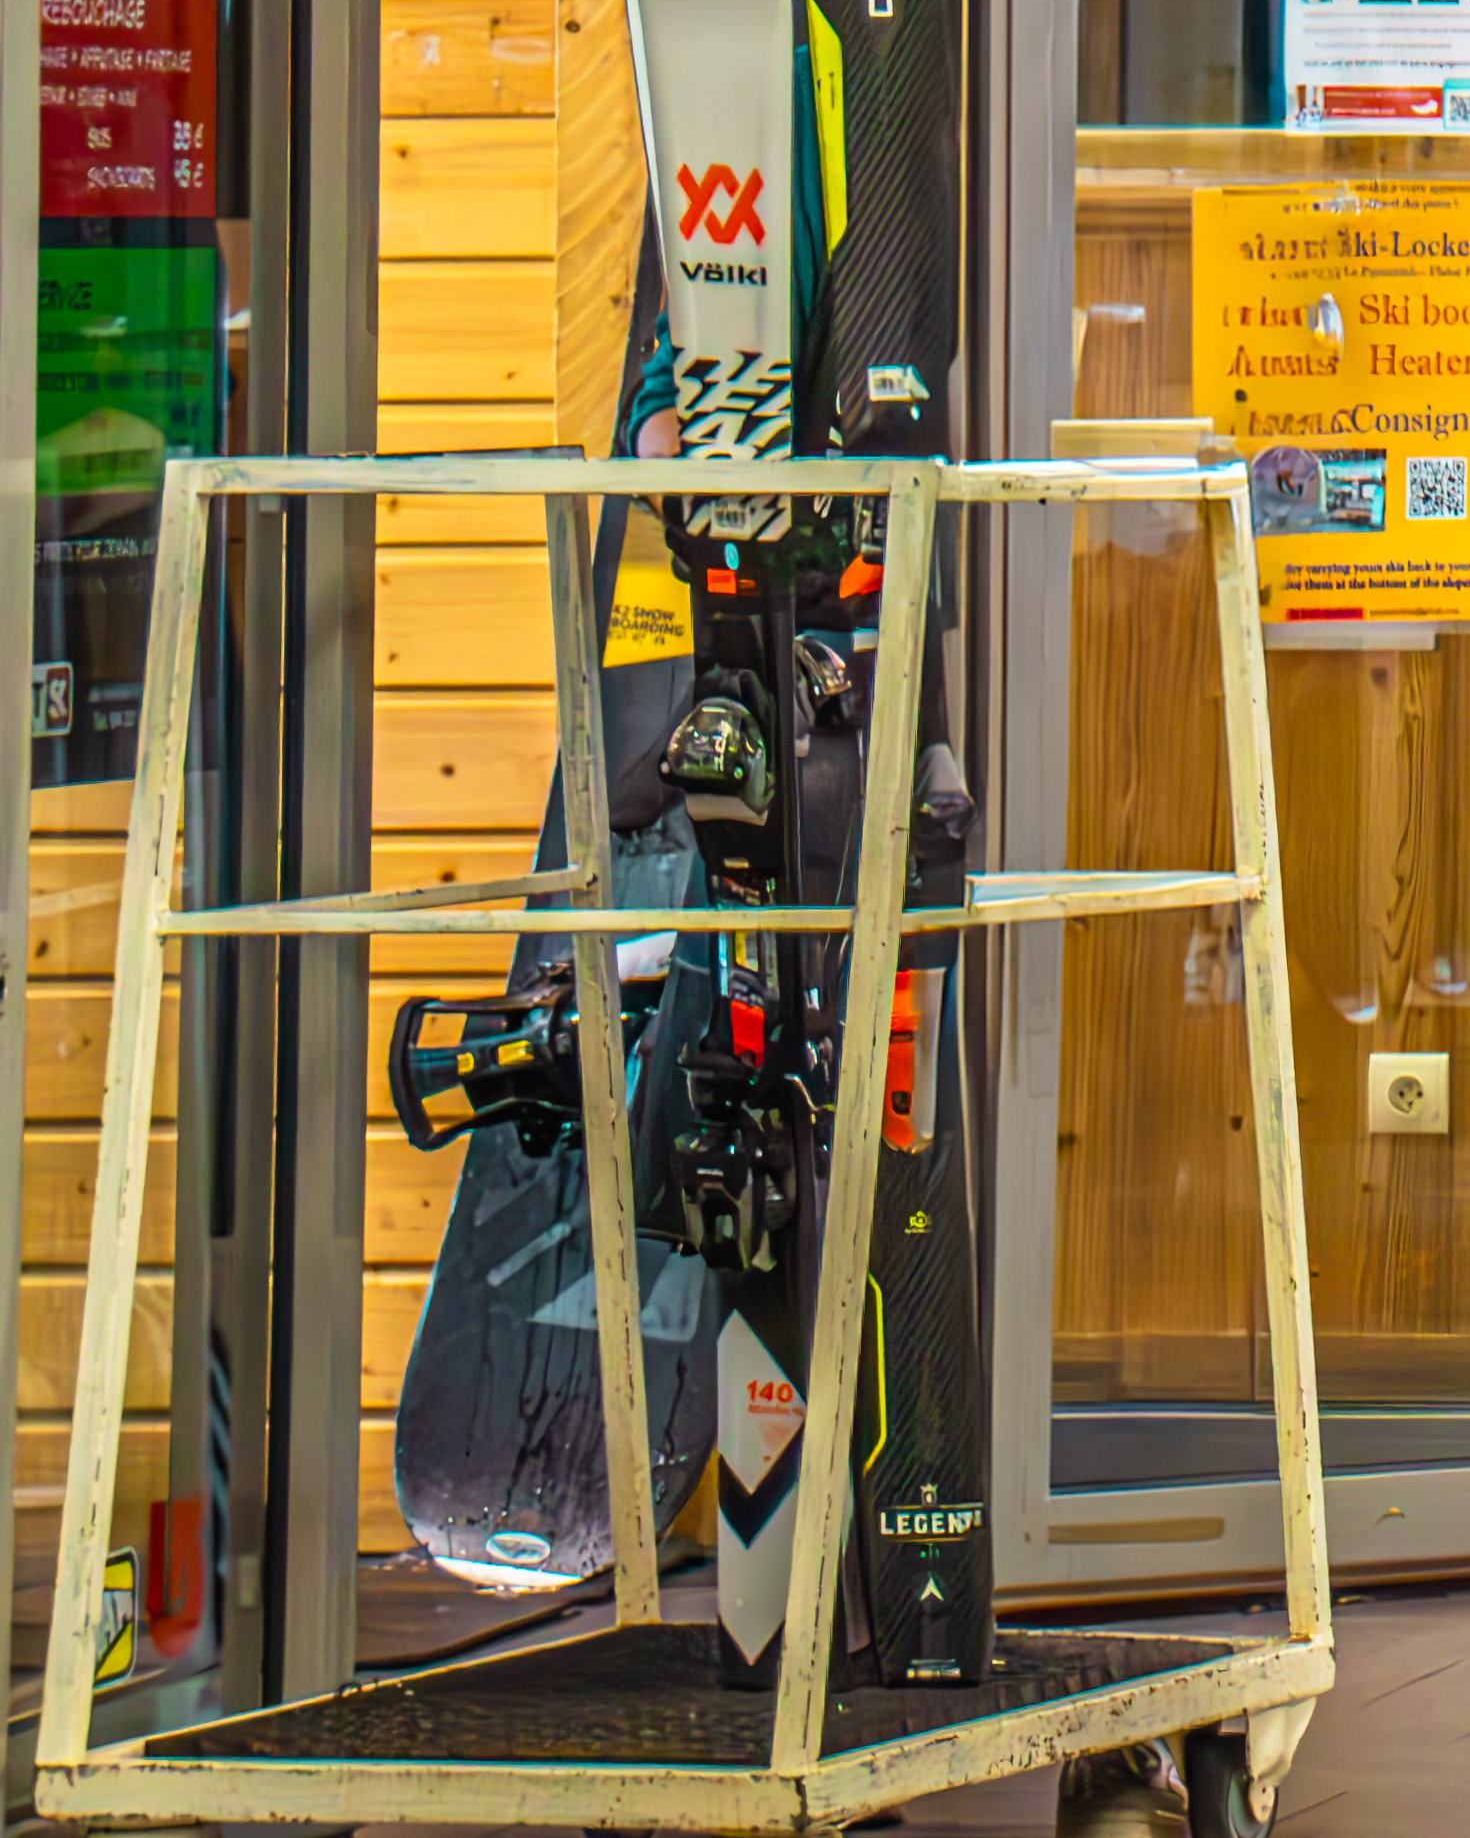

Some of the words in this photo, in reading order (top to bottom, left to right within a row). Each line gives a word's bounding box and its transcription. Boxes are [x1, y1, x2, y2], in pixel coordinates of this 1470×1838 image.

[679, 260, 768, 287] Völkl
[1359, 294, 1410, 326] Ski
[747, 1379, 794, 1404] 140
